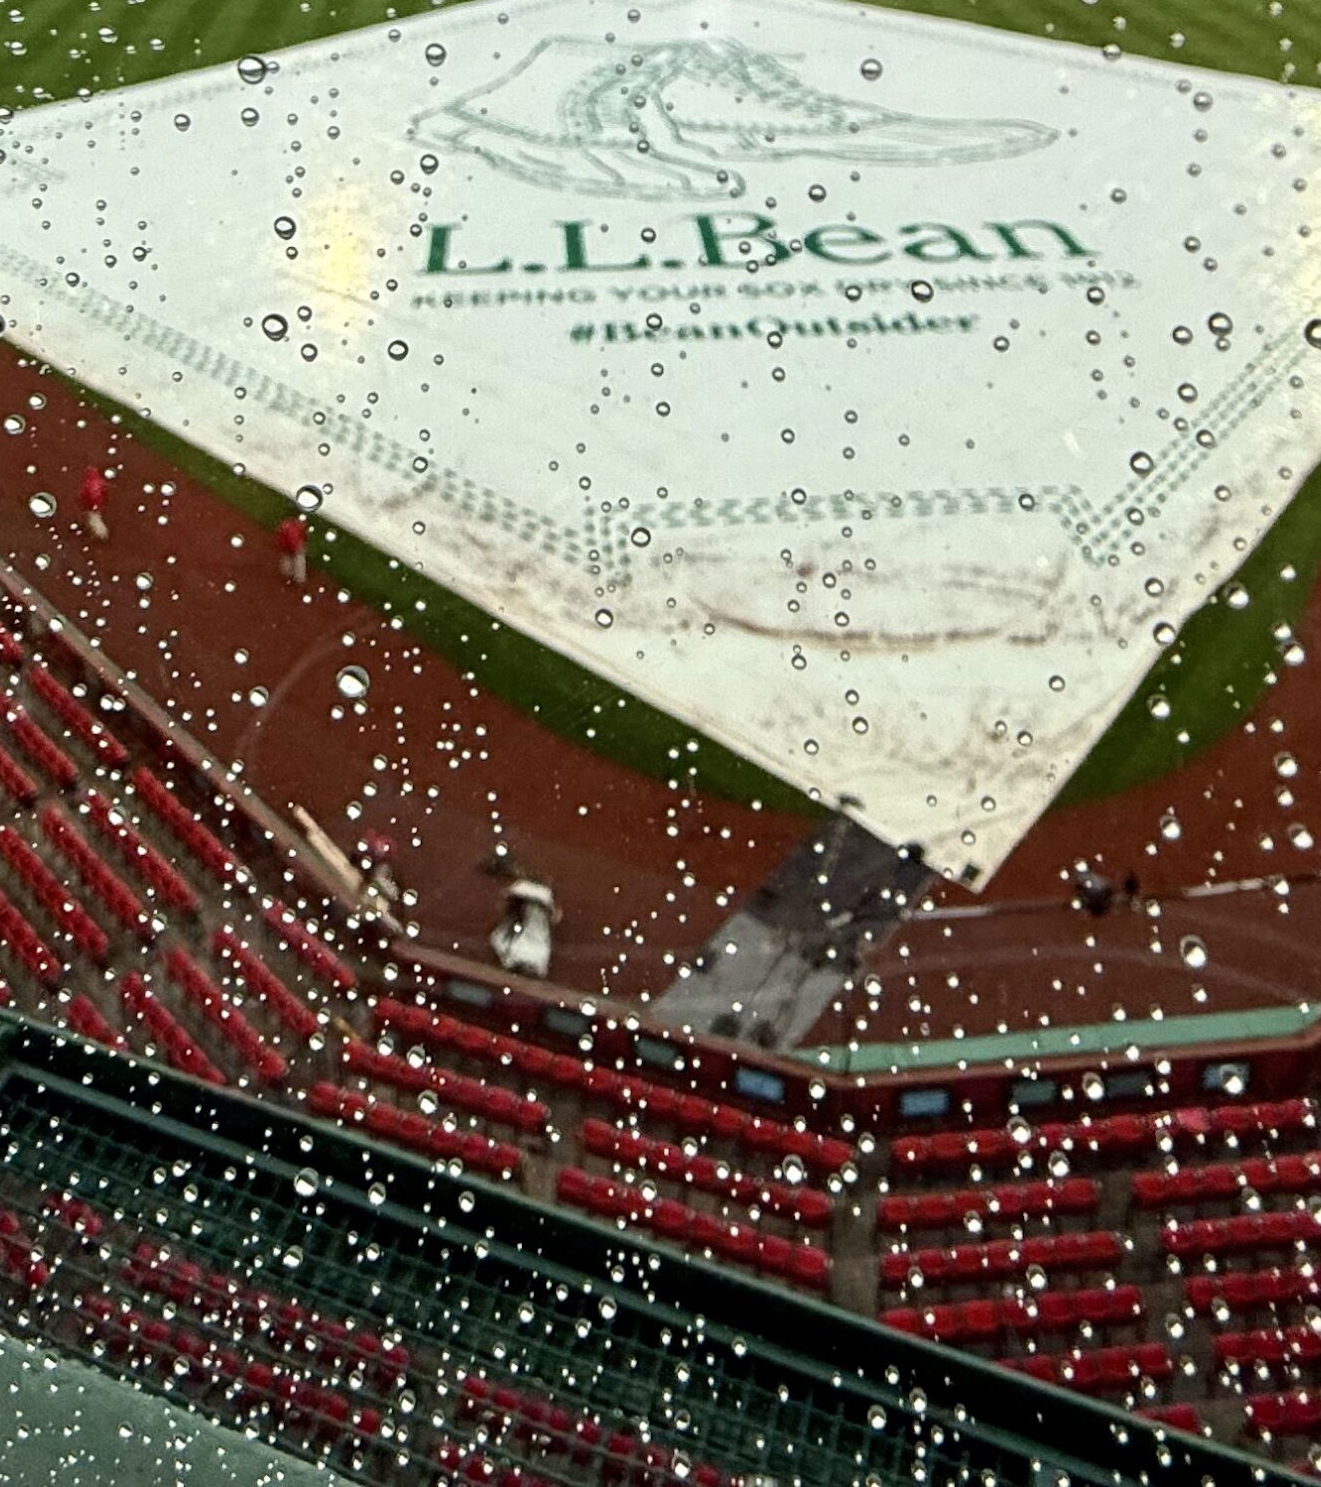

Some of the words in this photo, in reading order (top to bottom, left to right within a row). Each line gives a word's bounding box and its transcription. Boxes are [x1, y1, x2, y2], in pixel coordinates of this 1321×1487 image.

[416, 211, 1100, 274] L.L.Bean
[410, 283, 597, 310] KEEPING
[605, 282, 727, 303] YOUR
[737, 279, 825, 299] SOX
[569, 310, 980, 346] #BeanOutsider
